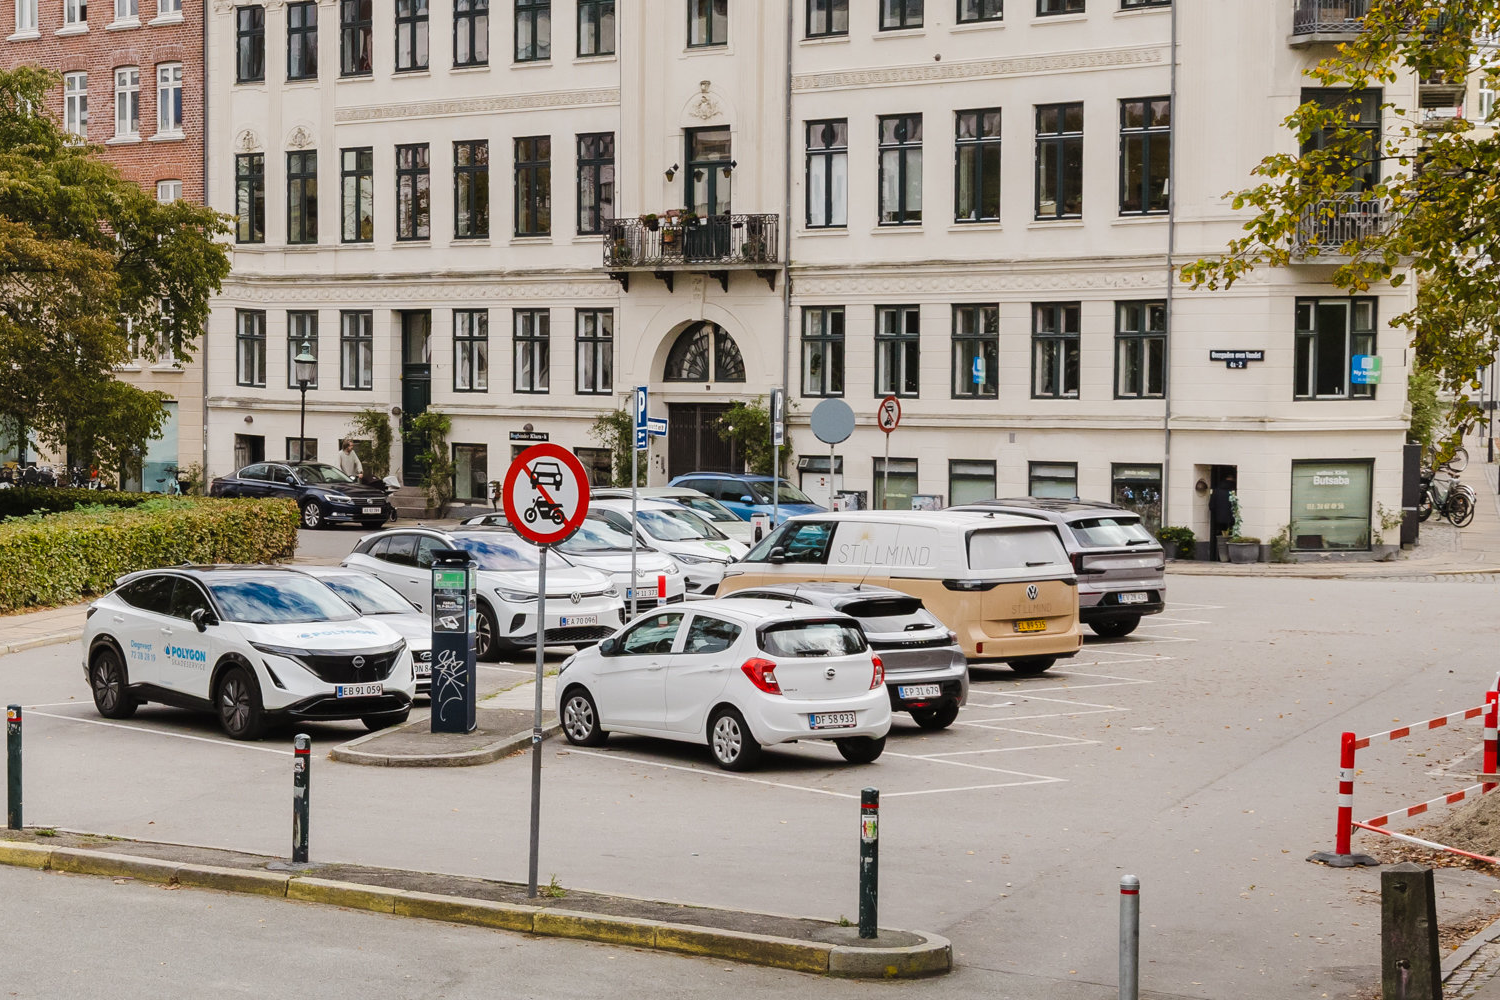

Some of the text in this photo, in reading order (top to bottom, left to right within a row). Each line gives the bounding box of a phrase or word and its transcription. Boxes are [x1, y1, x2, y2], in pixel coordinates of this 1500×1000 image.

[638, 391, 645, 423] P
[1313, 476, 1350, 485] Butsaba
[838, 543, 930, 566] STILLMIND
[171, 646, 206, 662] POLYGON
[172, 660, 206, 671] SKADESERVICE
[343, 684, 381, 696] EB 91 059
[904, 686, 939, 696] EP 31 679
[815, 713, 854, 724] DF 58 933
